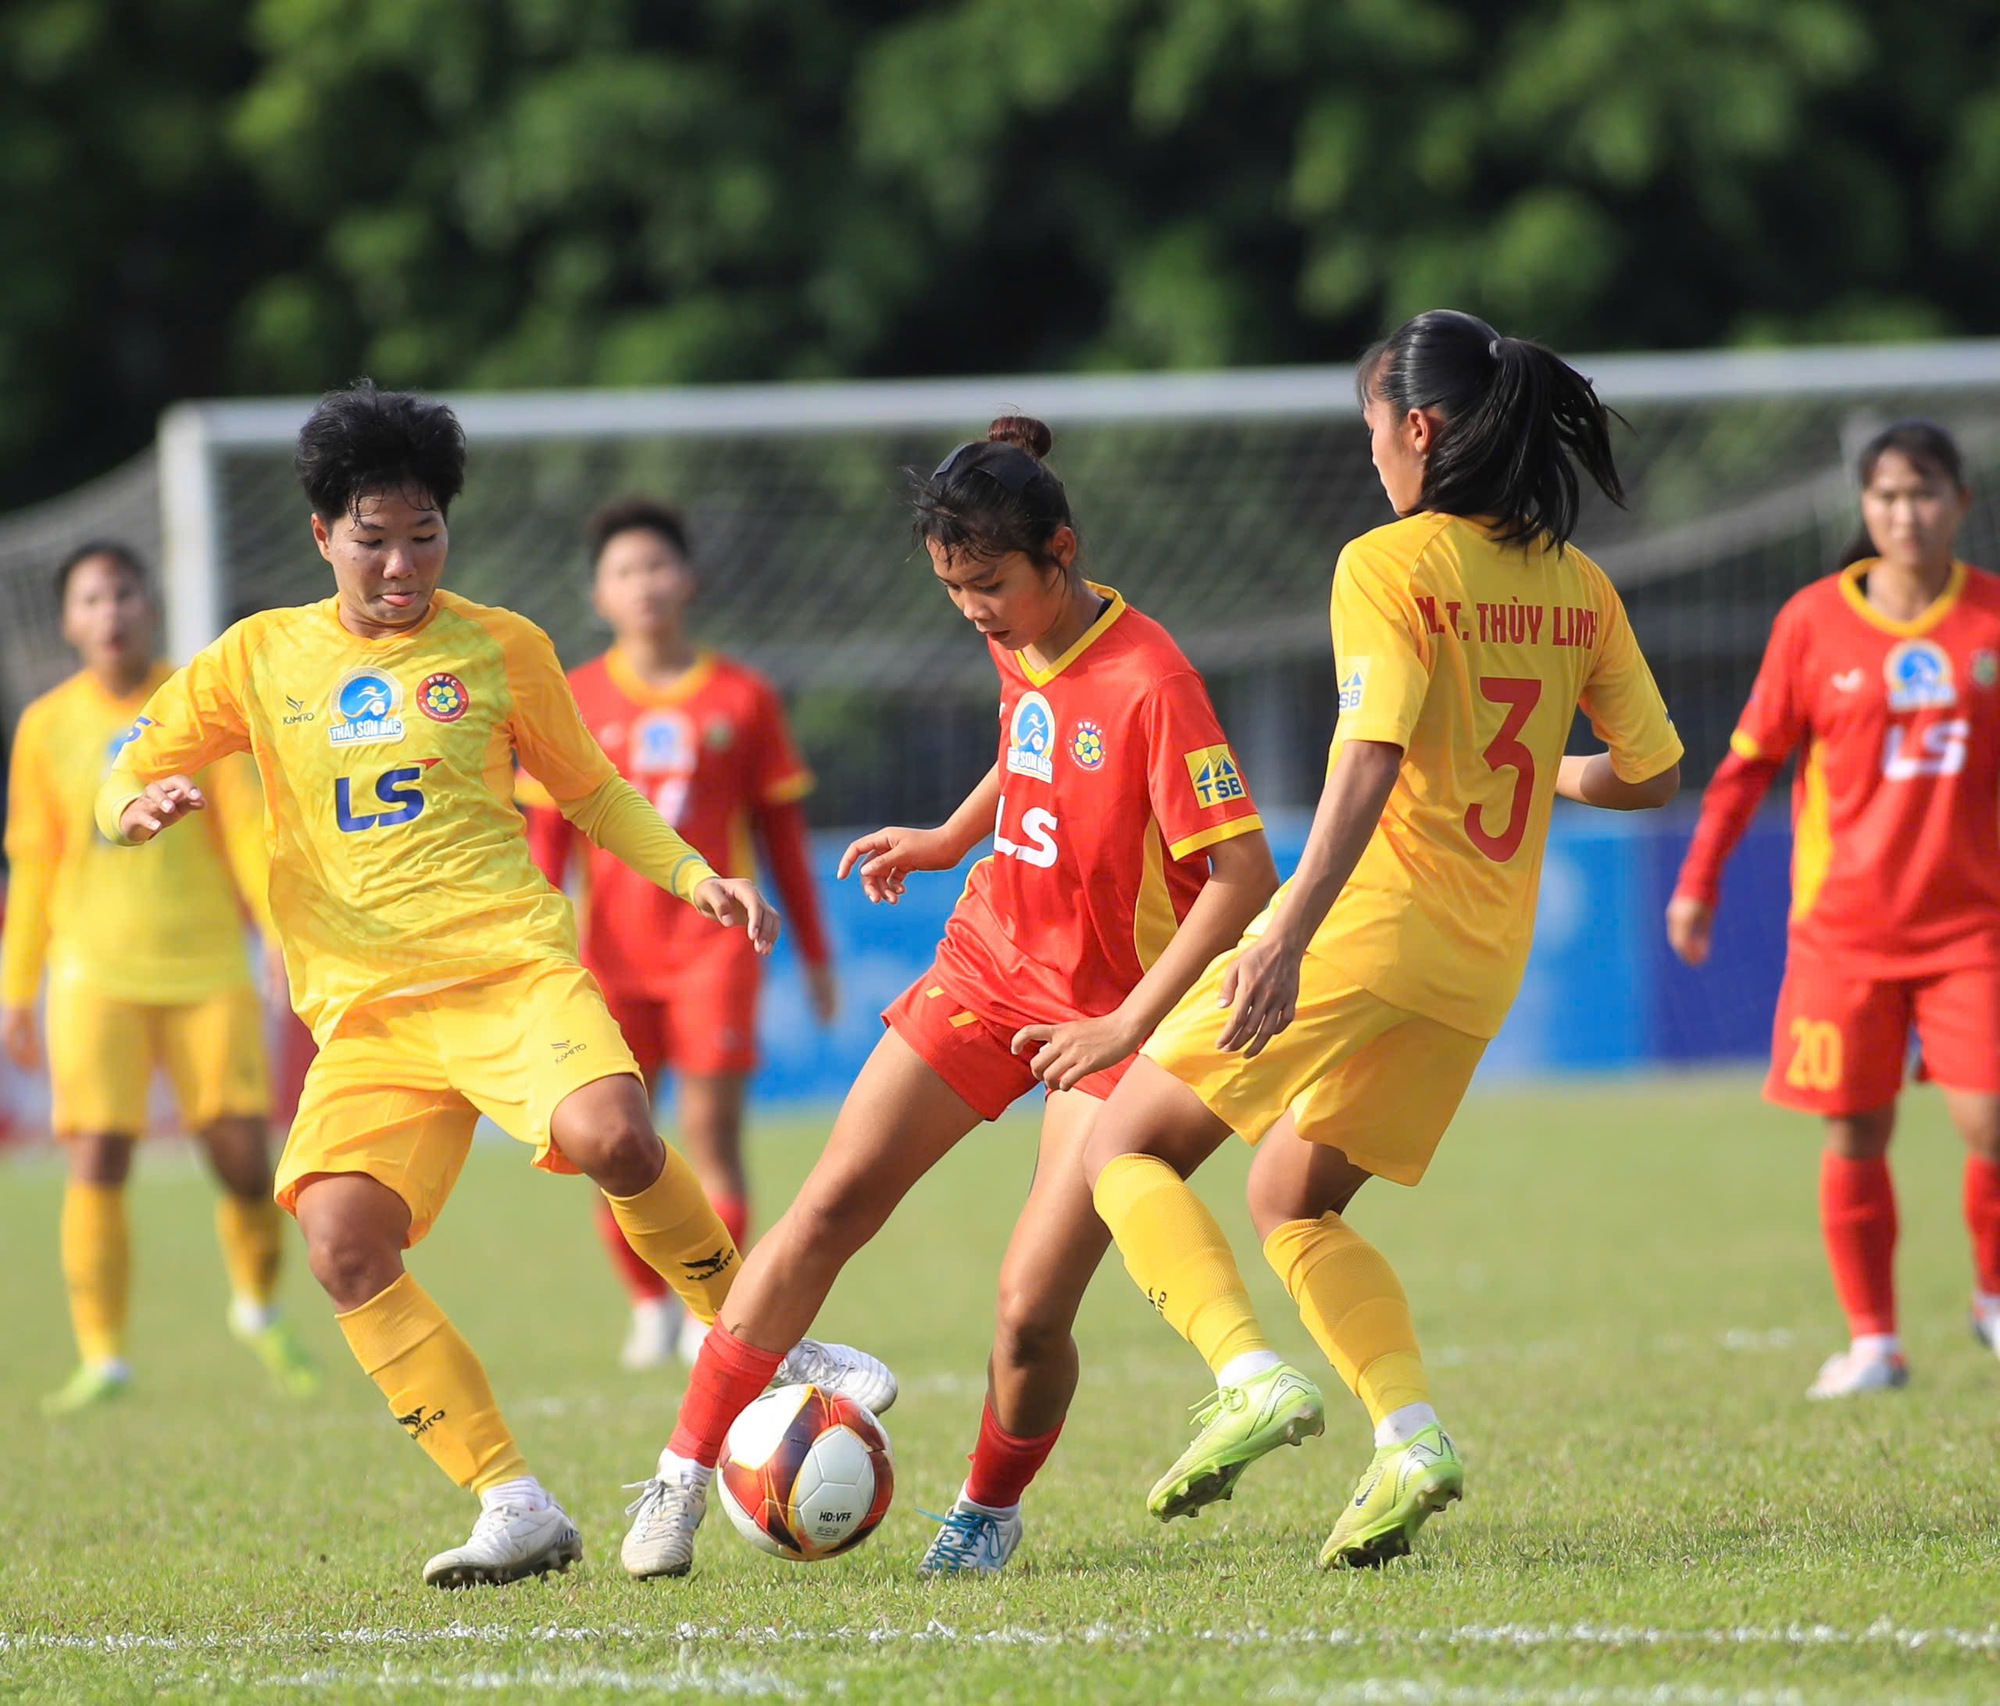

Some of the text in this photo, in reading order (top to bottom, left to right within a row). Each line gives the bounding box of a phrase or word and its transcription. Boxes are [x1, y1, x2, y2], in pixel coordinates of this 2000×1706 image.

[1476, 596, 1543, 645] THÙY
[1552, 606, 1598, 649] LINH
[1338, 689, 1361, 709] SB
[1464, 676, 1542, 863] 3
[1881, 718, 1970, 780] LS
[334, 766, 425, 833] LS
[1197, 777, 1243, 803] TSB
[994, 795, 1058, 868] LS
[1785, 1015, 1844, 1091] 20
[819, 1511, 852, 1522] HD:VFF
